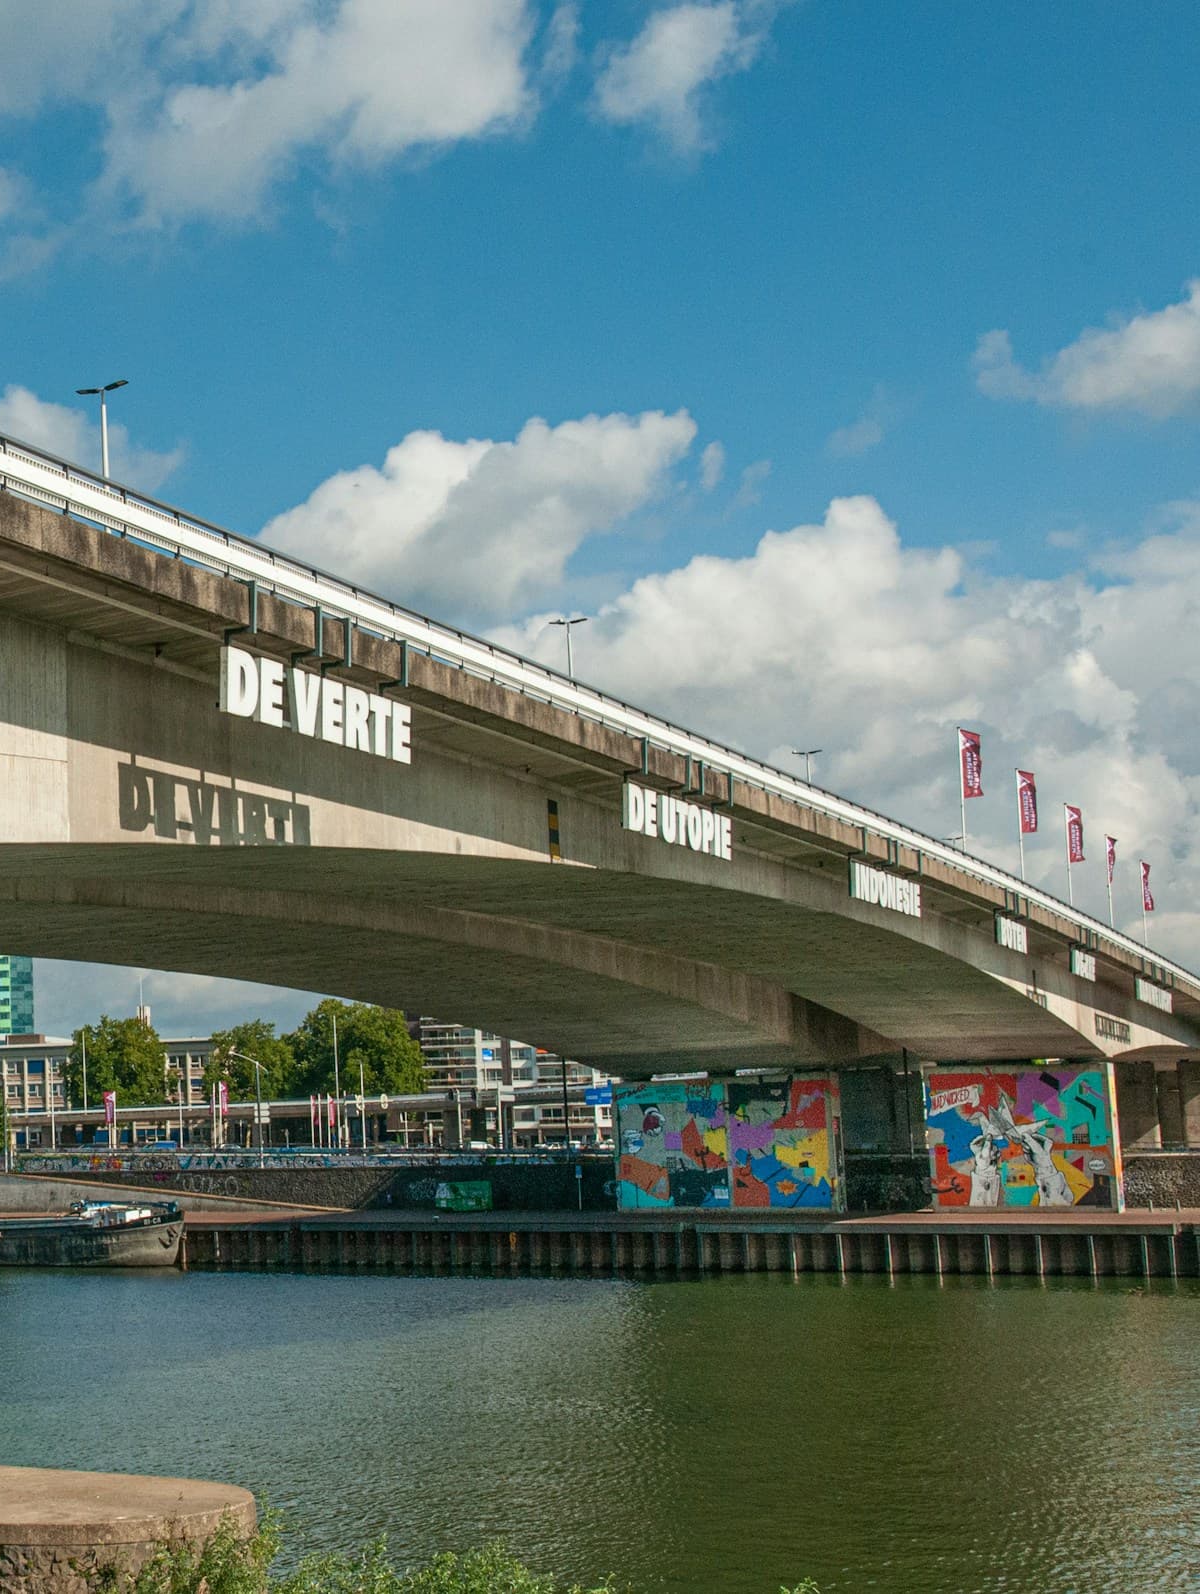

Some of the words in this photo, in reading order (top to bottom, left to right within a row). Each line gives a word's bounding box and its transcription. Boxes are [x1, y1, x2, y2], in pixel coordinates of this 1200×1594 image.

[220, 645, 284, 728] DE
[287, 667, 412, 765] VERTE
[623, 782, 657, 837] DE
[657, 794, 732, 860] UTOPIE
[851, 861, 921, 918] INDONESIE
